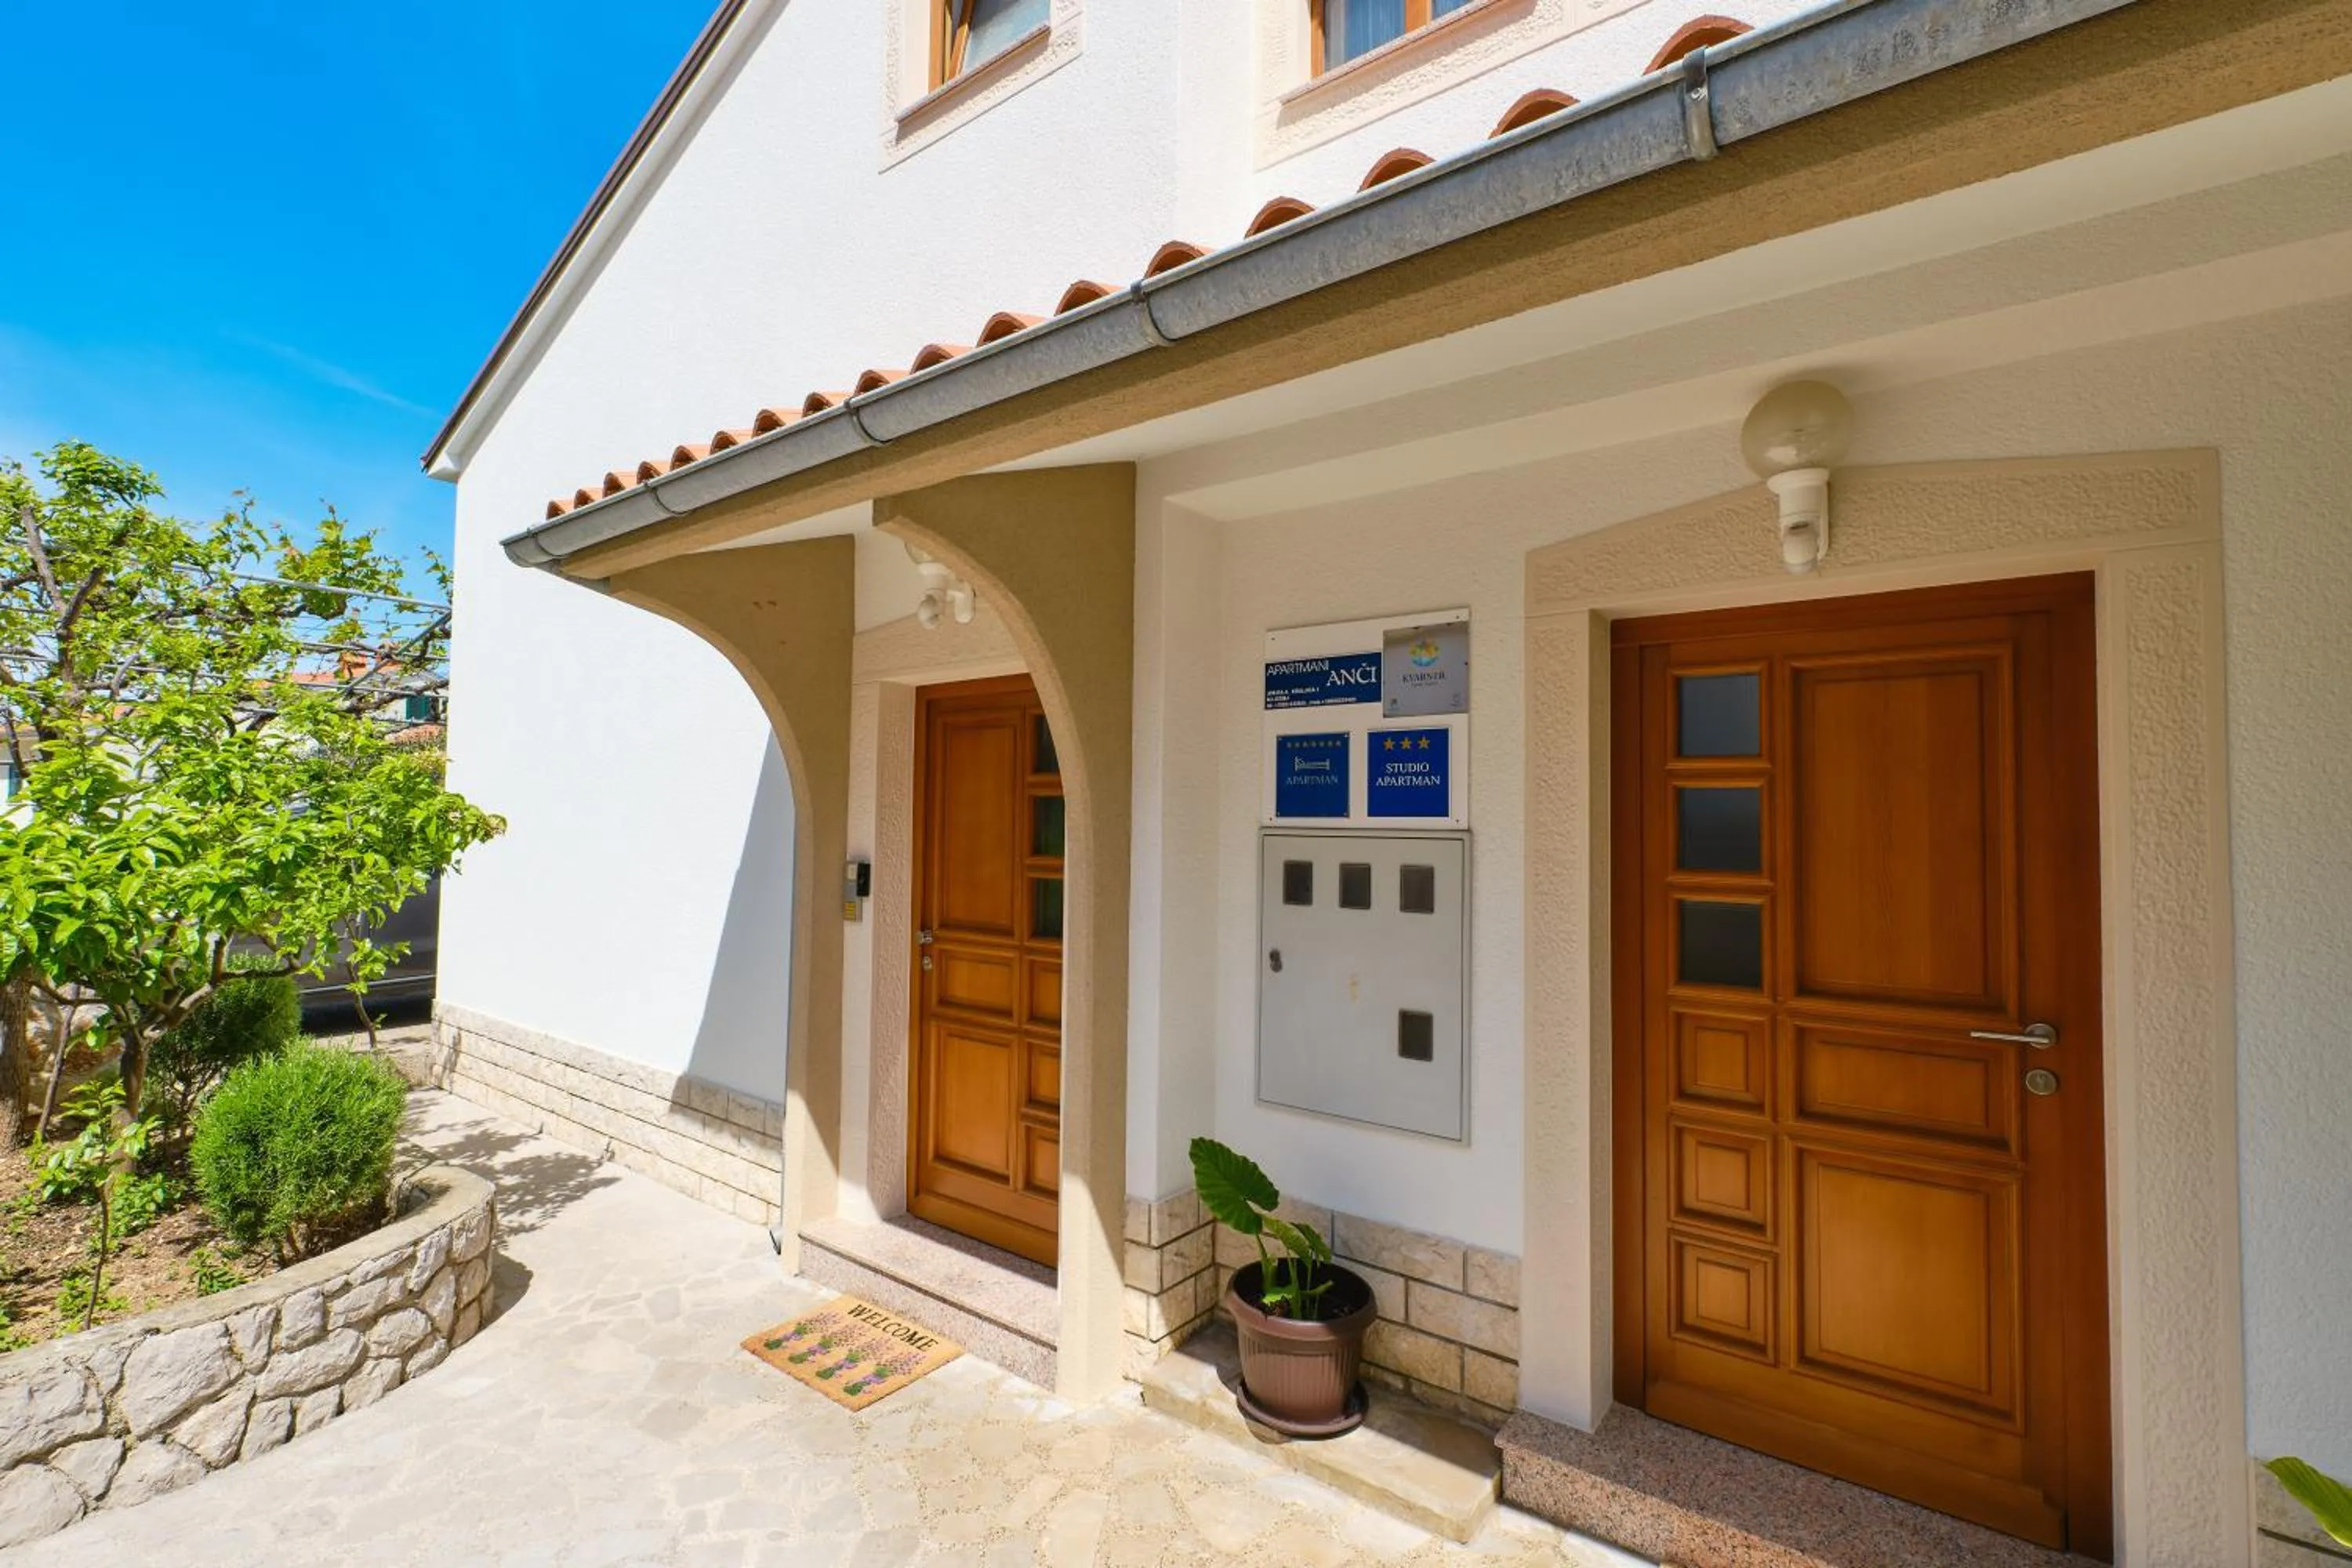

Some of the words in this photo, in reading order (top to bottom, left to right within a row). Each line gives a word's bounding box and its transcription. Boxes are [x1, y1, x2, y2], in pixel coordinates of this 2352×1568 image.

[1266, 659, 1329, 676] APARTMANI
[1385, 761, 1429, 773] STUDIO
[1286, 774, 1339, 785] APARTMAN
[1376, 775, 1441, 786] APARTMAN
[847, 1304, 939, 1352] WELCOME
